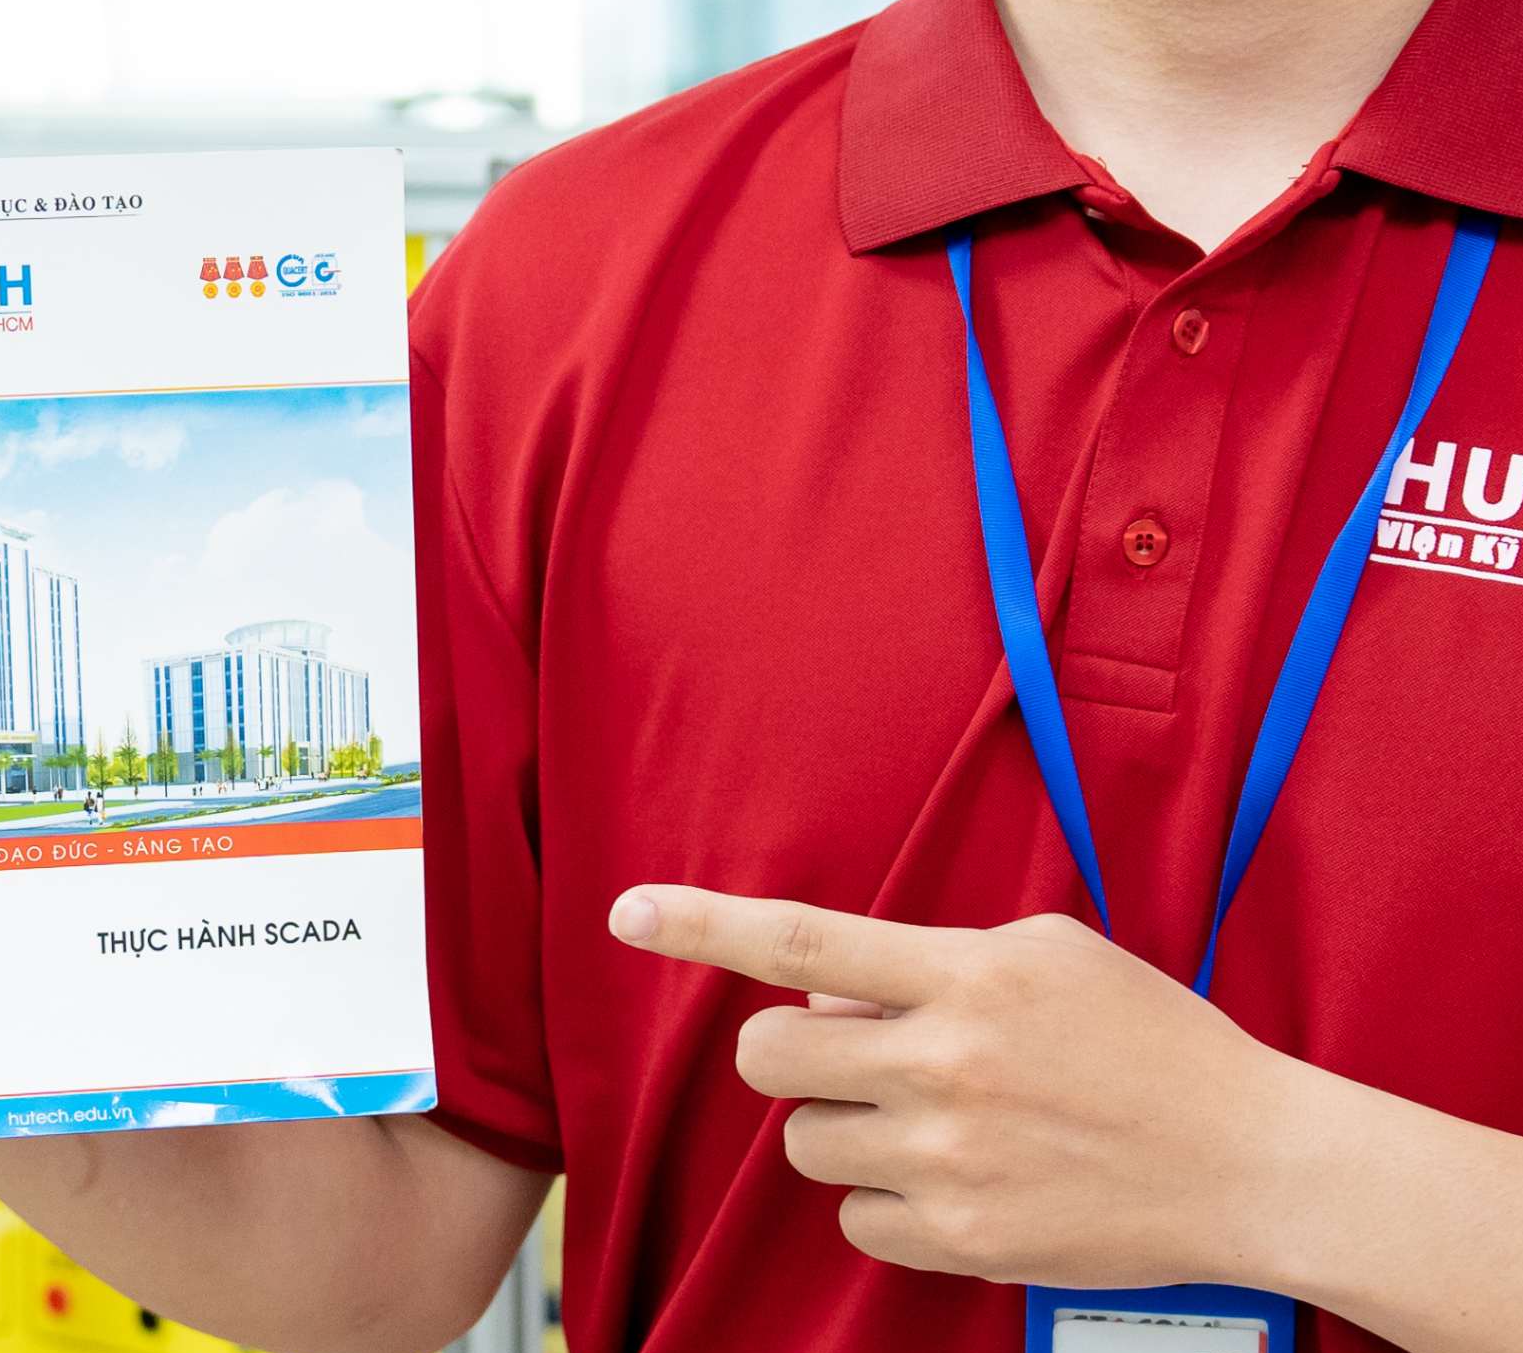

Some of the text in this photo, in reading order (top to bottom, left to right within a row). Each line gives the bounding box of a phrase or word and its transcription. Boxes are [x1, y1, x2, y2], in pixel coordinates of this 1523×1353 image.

[34, 198, 48, 212] &
[54, 192, 96, 212] ĐÀO
[102, 193, 143, 213] TẠO
[52, 840, 98, 862] ĐỨC
[123, 836, 182, 857] SÁNG
[192, 836, 234, 856] TẠO
[97, 918, 362, 958] THỰC HÀNH SCADA
[8, 1106, 134, 1126] hutech.edu.vn
